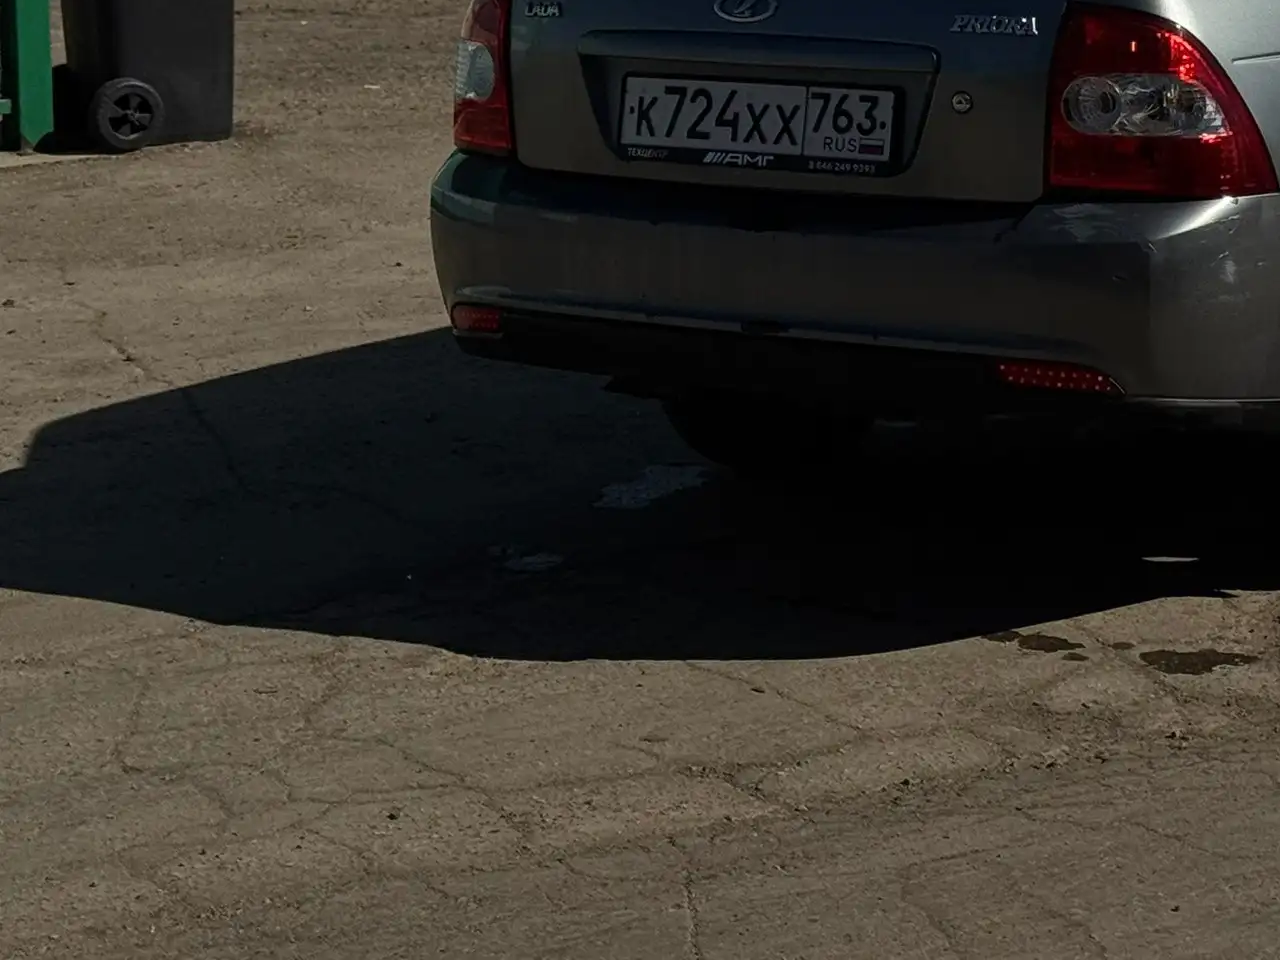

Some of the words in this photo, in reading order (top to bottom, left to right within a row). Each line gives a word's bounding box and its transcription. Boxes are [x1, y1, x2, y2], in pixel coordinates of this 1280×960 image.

[524, 1, 561, 17] LADA
[949, 13, 1039, 36] PRIORA
[810, 92, 880, 137] 763
[823, 136, 858, 153] RUS
